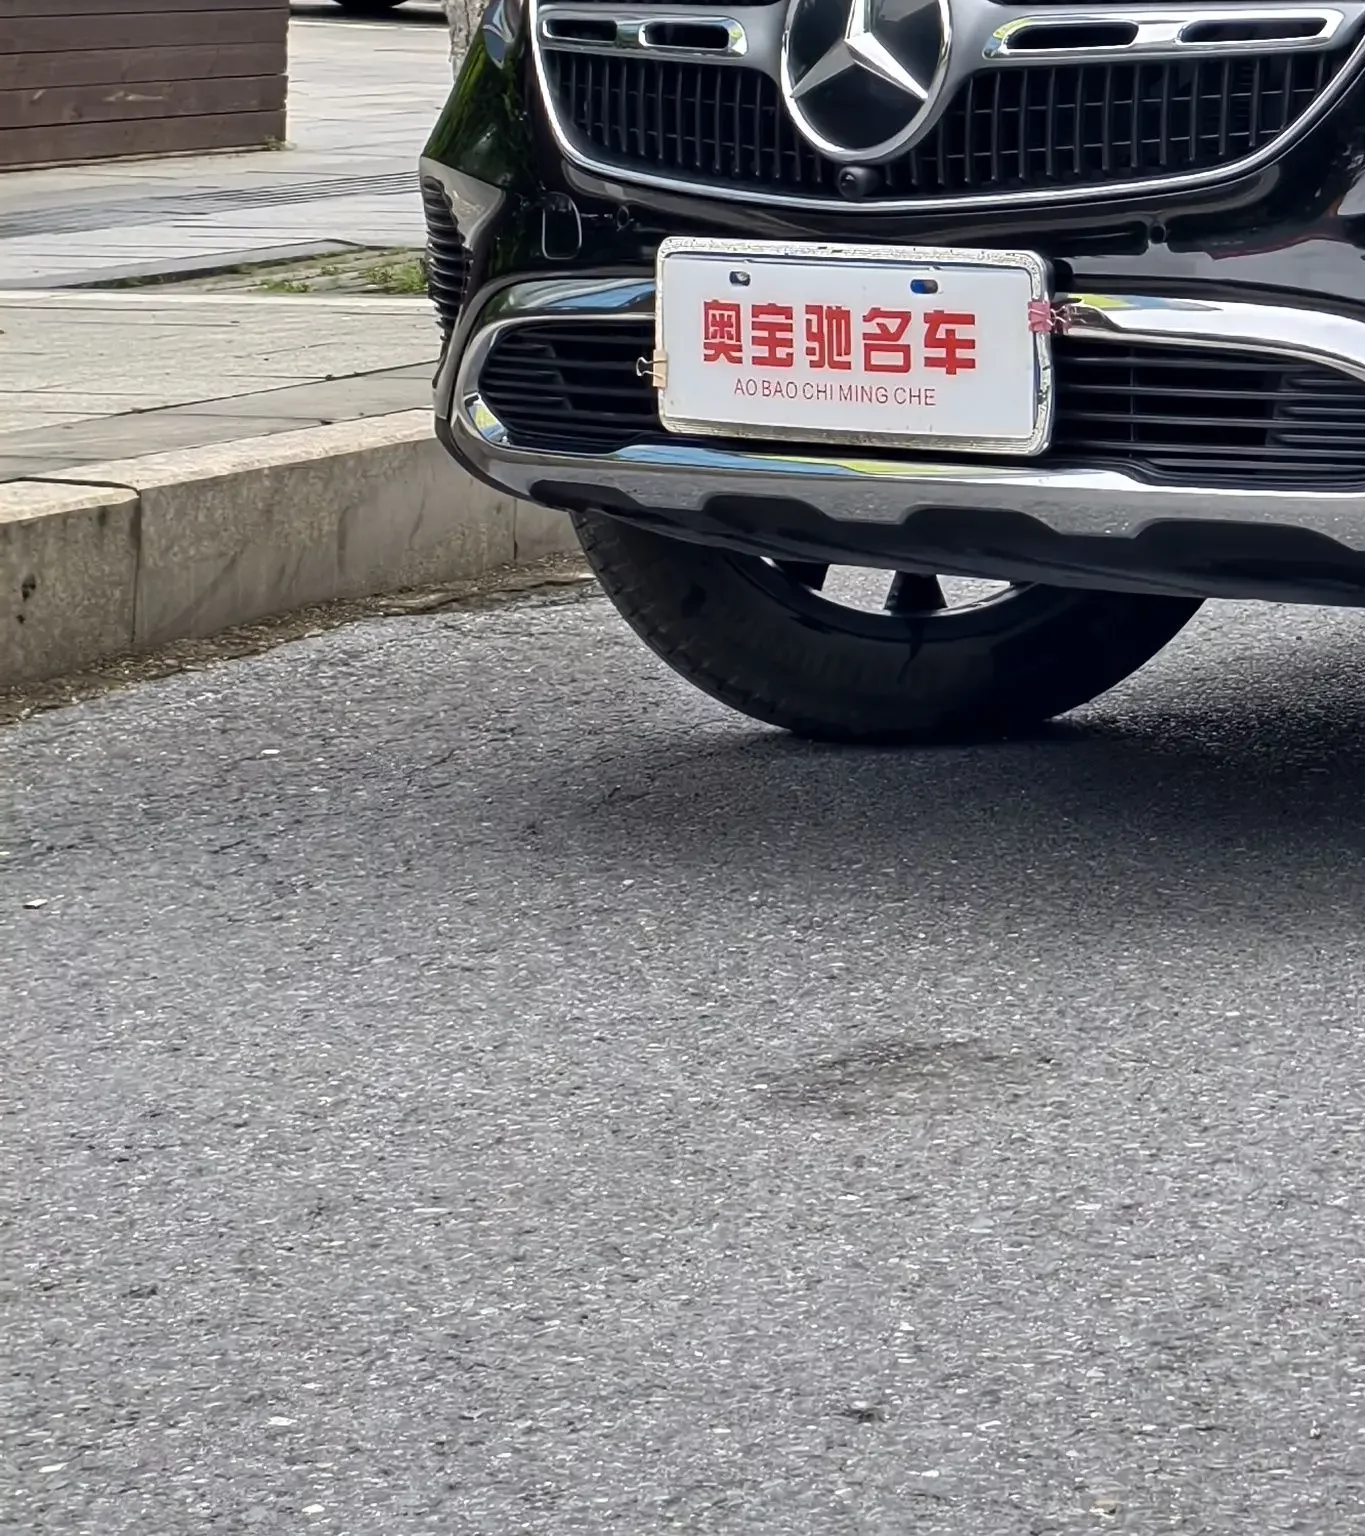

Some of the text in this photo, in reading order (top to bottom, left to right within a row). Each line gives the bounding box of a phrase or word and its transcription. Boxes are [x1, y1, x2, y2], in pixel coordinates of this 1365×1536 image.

[703, 299, 976, 375] 奥宝驰名车
[734, 378, 936, 406] AO BAO CHI MING CHE
